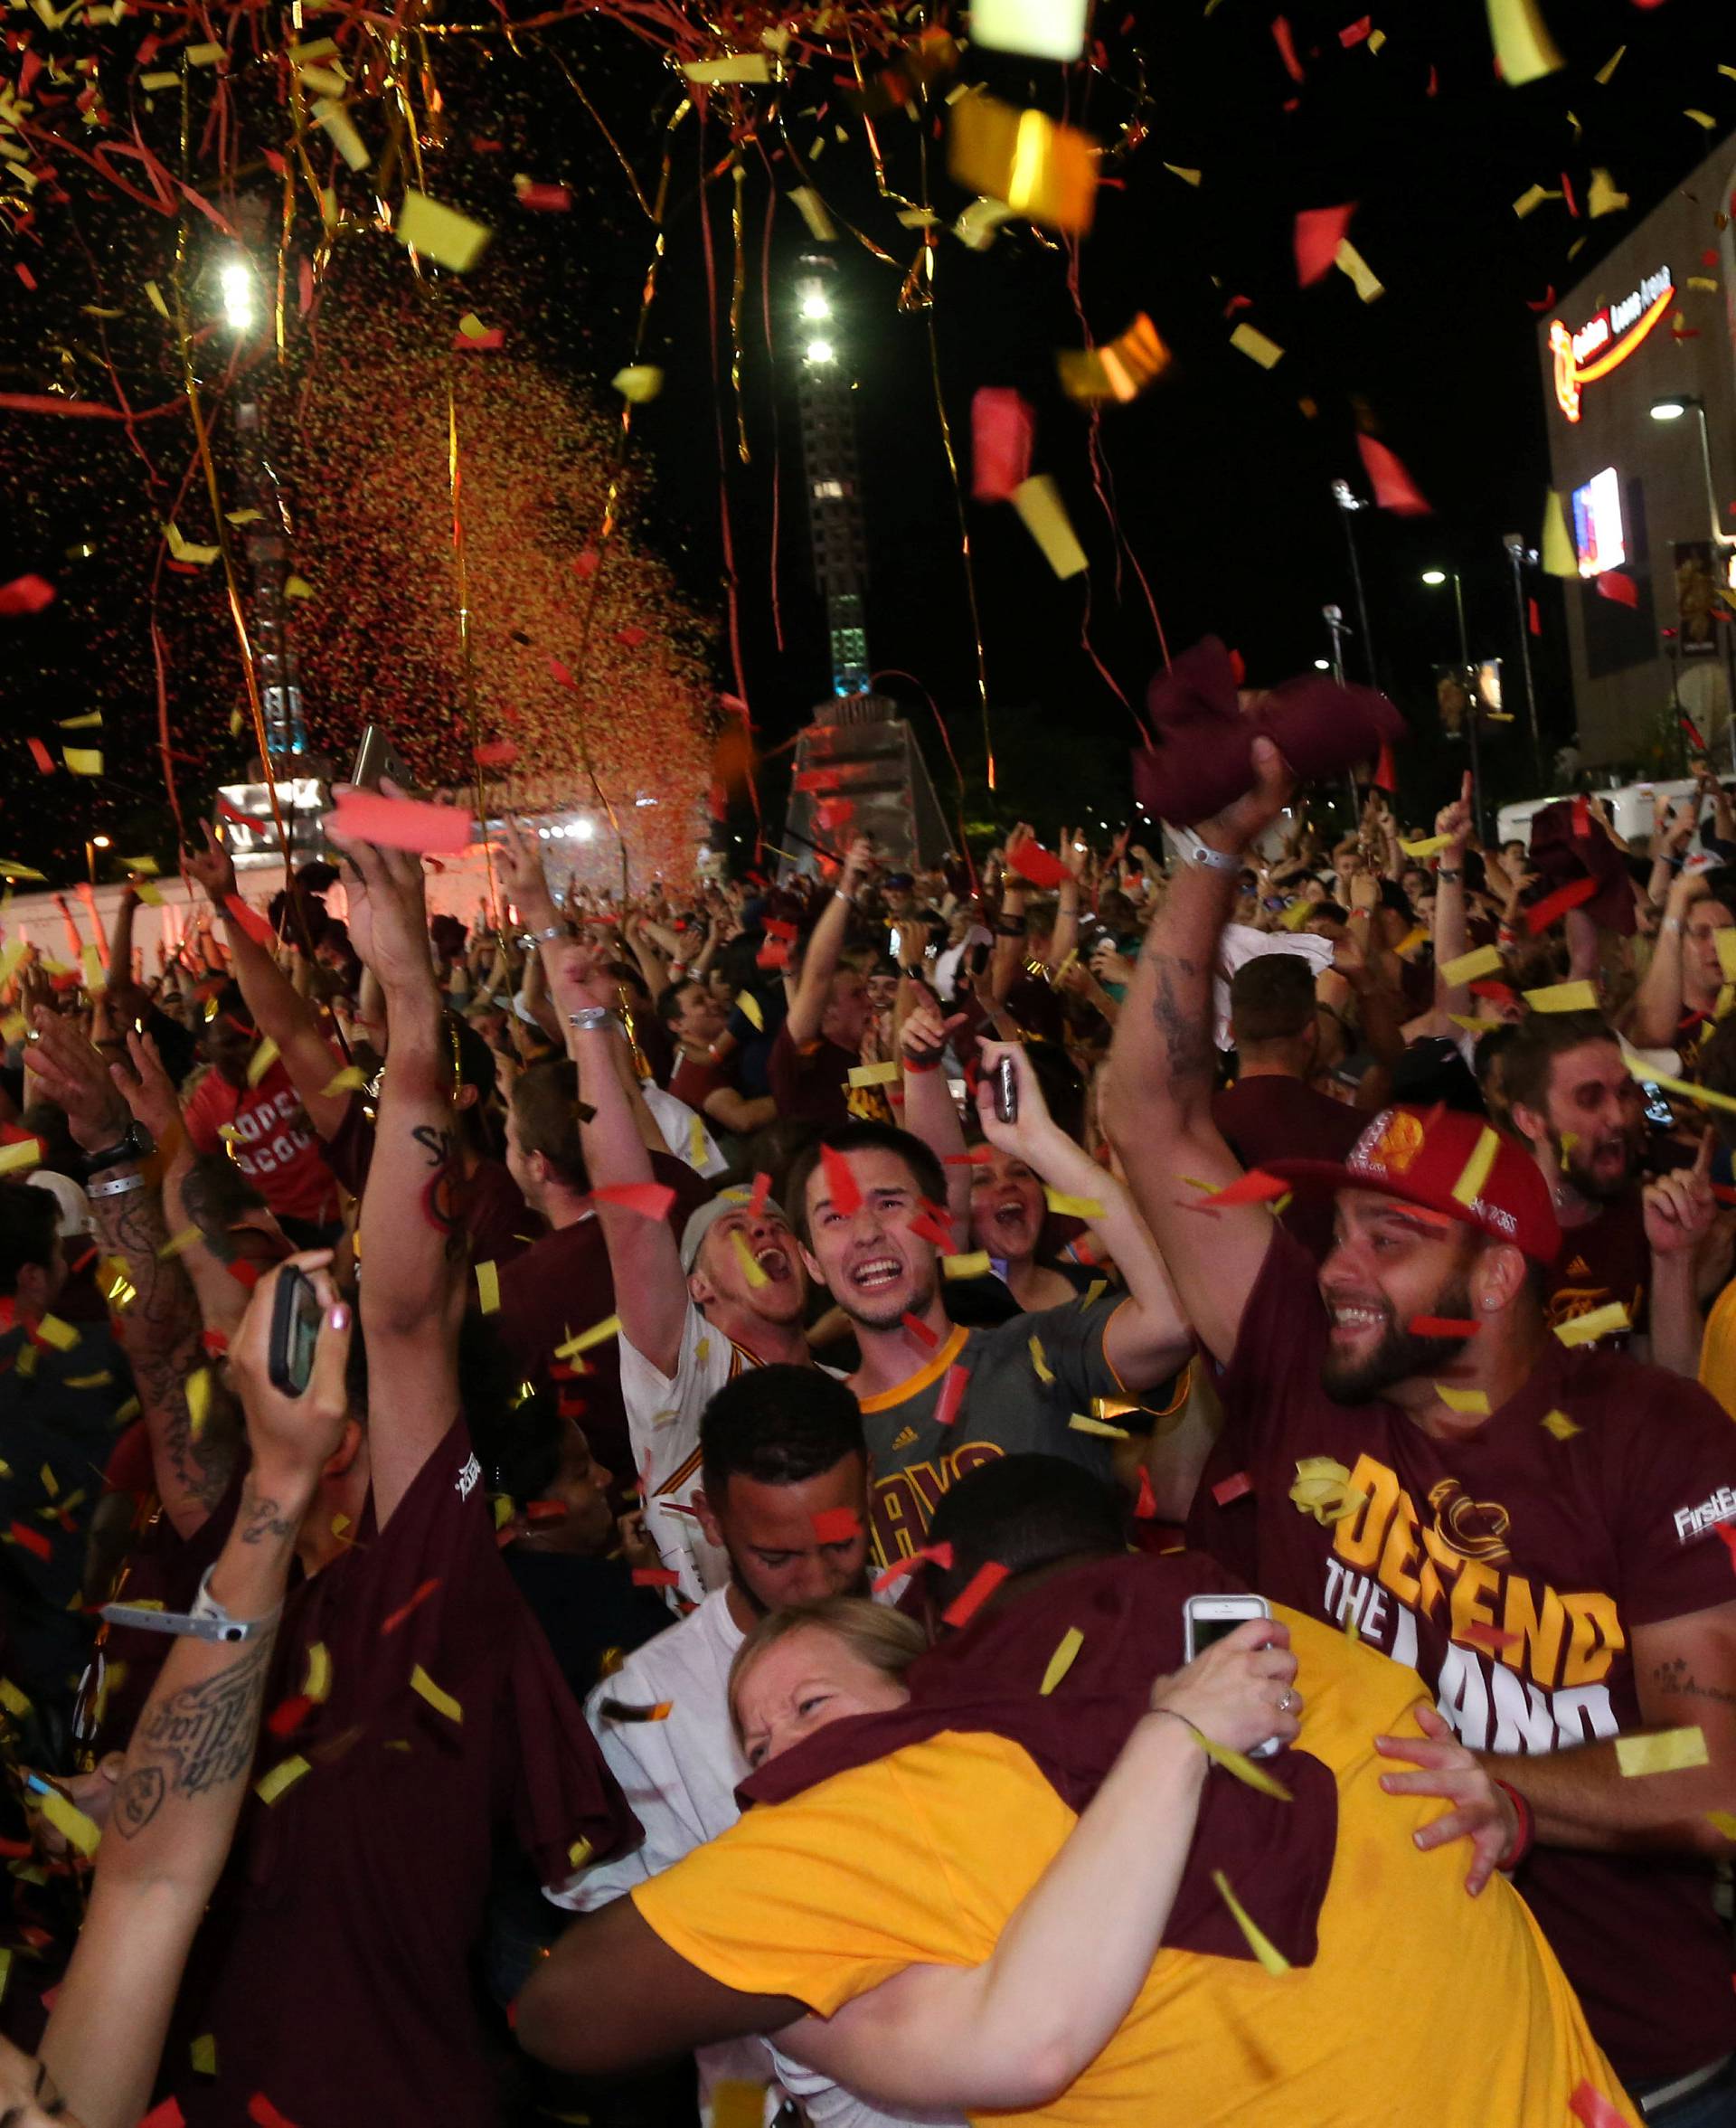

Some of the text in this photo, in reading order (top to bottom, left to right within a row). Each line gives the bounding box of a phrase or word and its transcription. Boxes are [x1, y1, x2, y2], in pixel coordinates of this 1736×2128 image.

[1673, 1486, 1736, 1543] FirstE
[1324, 1556, 1389, 1640] THE
[1332, 1452, 1625, 1690] DEFEND
